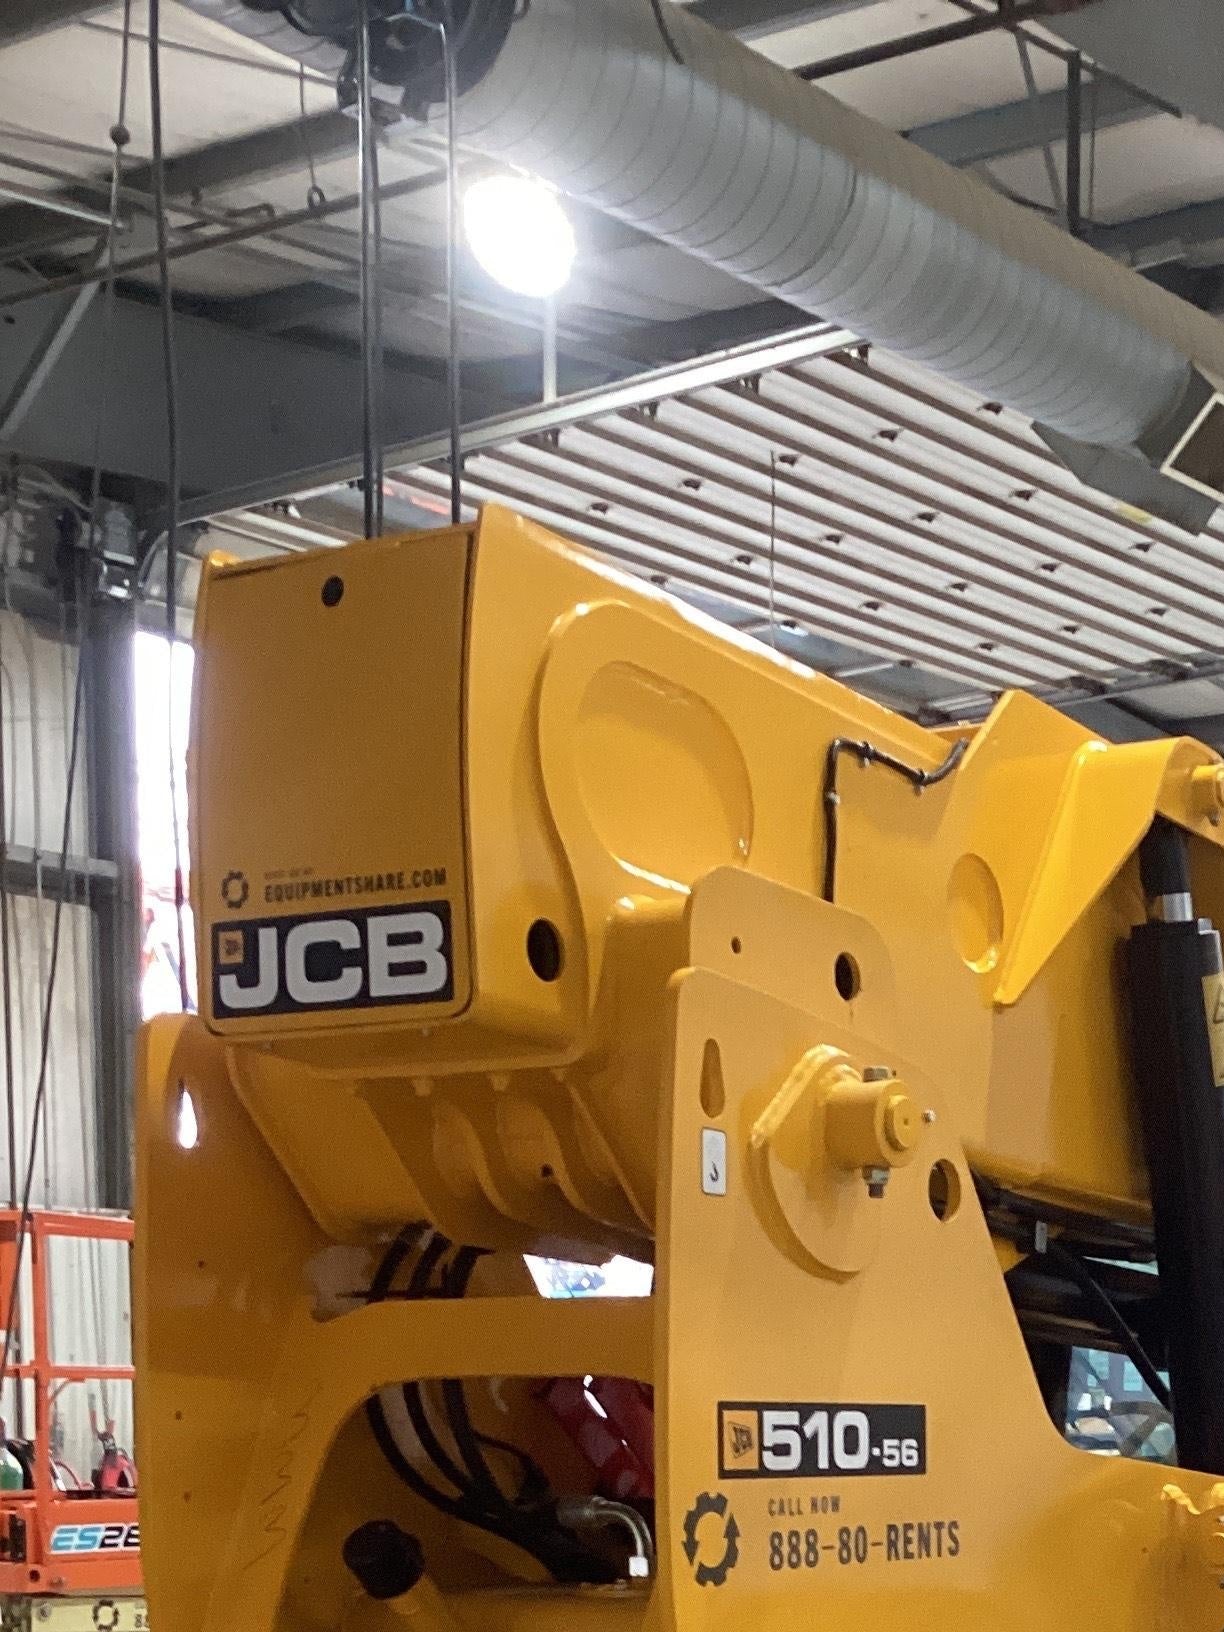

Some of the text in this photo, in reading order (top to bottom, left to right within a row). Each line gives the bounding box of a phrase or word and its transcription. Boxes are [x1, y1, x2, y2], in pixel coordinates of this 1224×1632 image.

[264, 867, 447, 903] EQUIPMENTSHARE.COM
[219, 912, 447, 1009] JCB
[768, 1495, 841, 1518] CALL NOW
[768, 1520, 961, 1571] 888-80-RENTS
